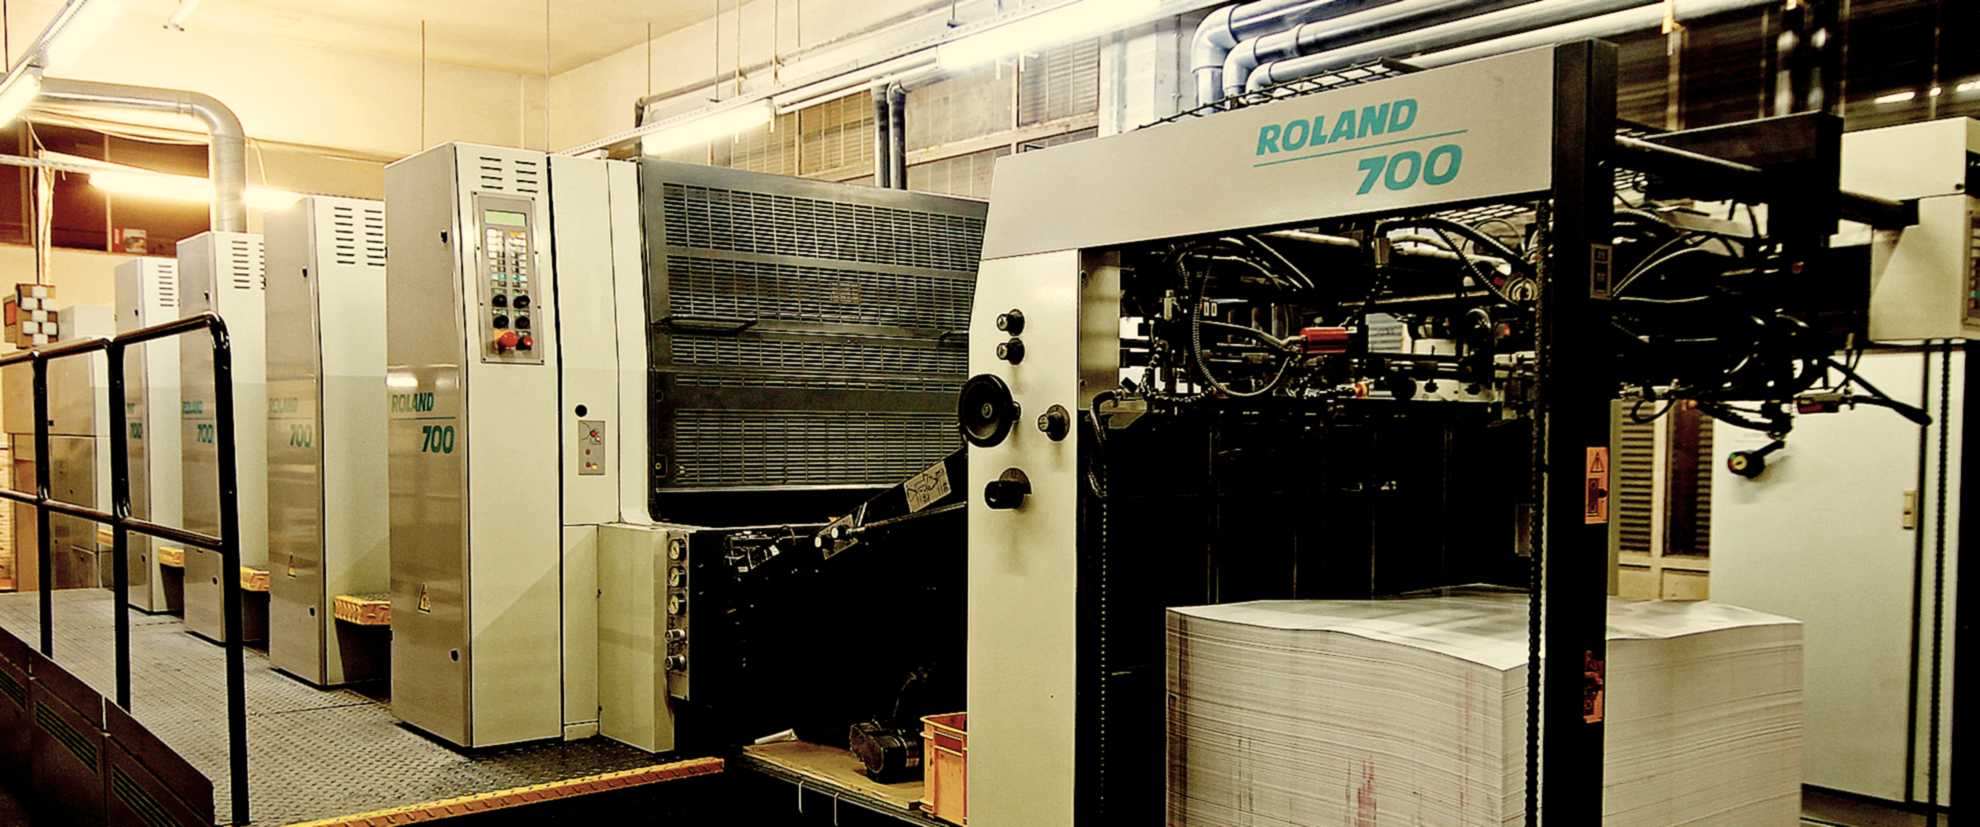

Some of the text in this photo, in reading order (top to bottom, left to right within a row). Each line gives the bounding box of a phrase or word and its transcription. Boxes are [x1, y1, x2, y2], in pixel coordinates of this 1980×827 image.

[1256, 98, 1418, 155] ROLAND
[1356, 144, 1463, 195] 700
[391, 392, 434, 412] ROLAND
[197, 423, 213, 443] 700
[289, 423, 313, 448] 700
[422, 425, 455, 454] 700
